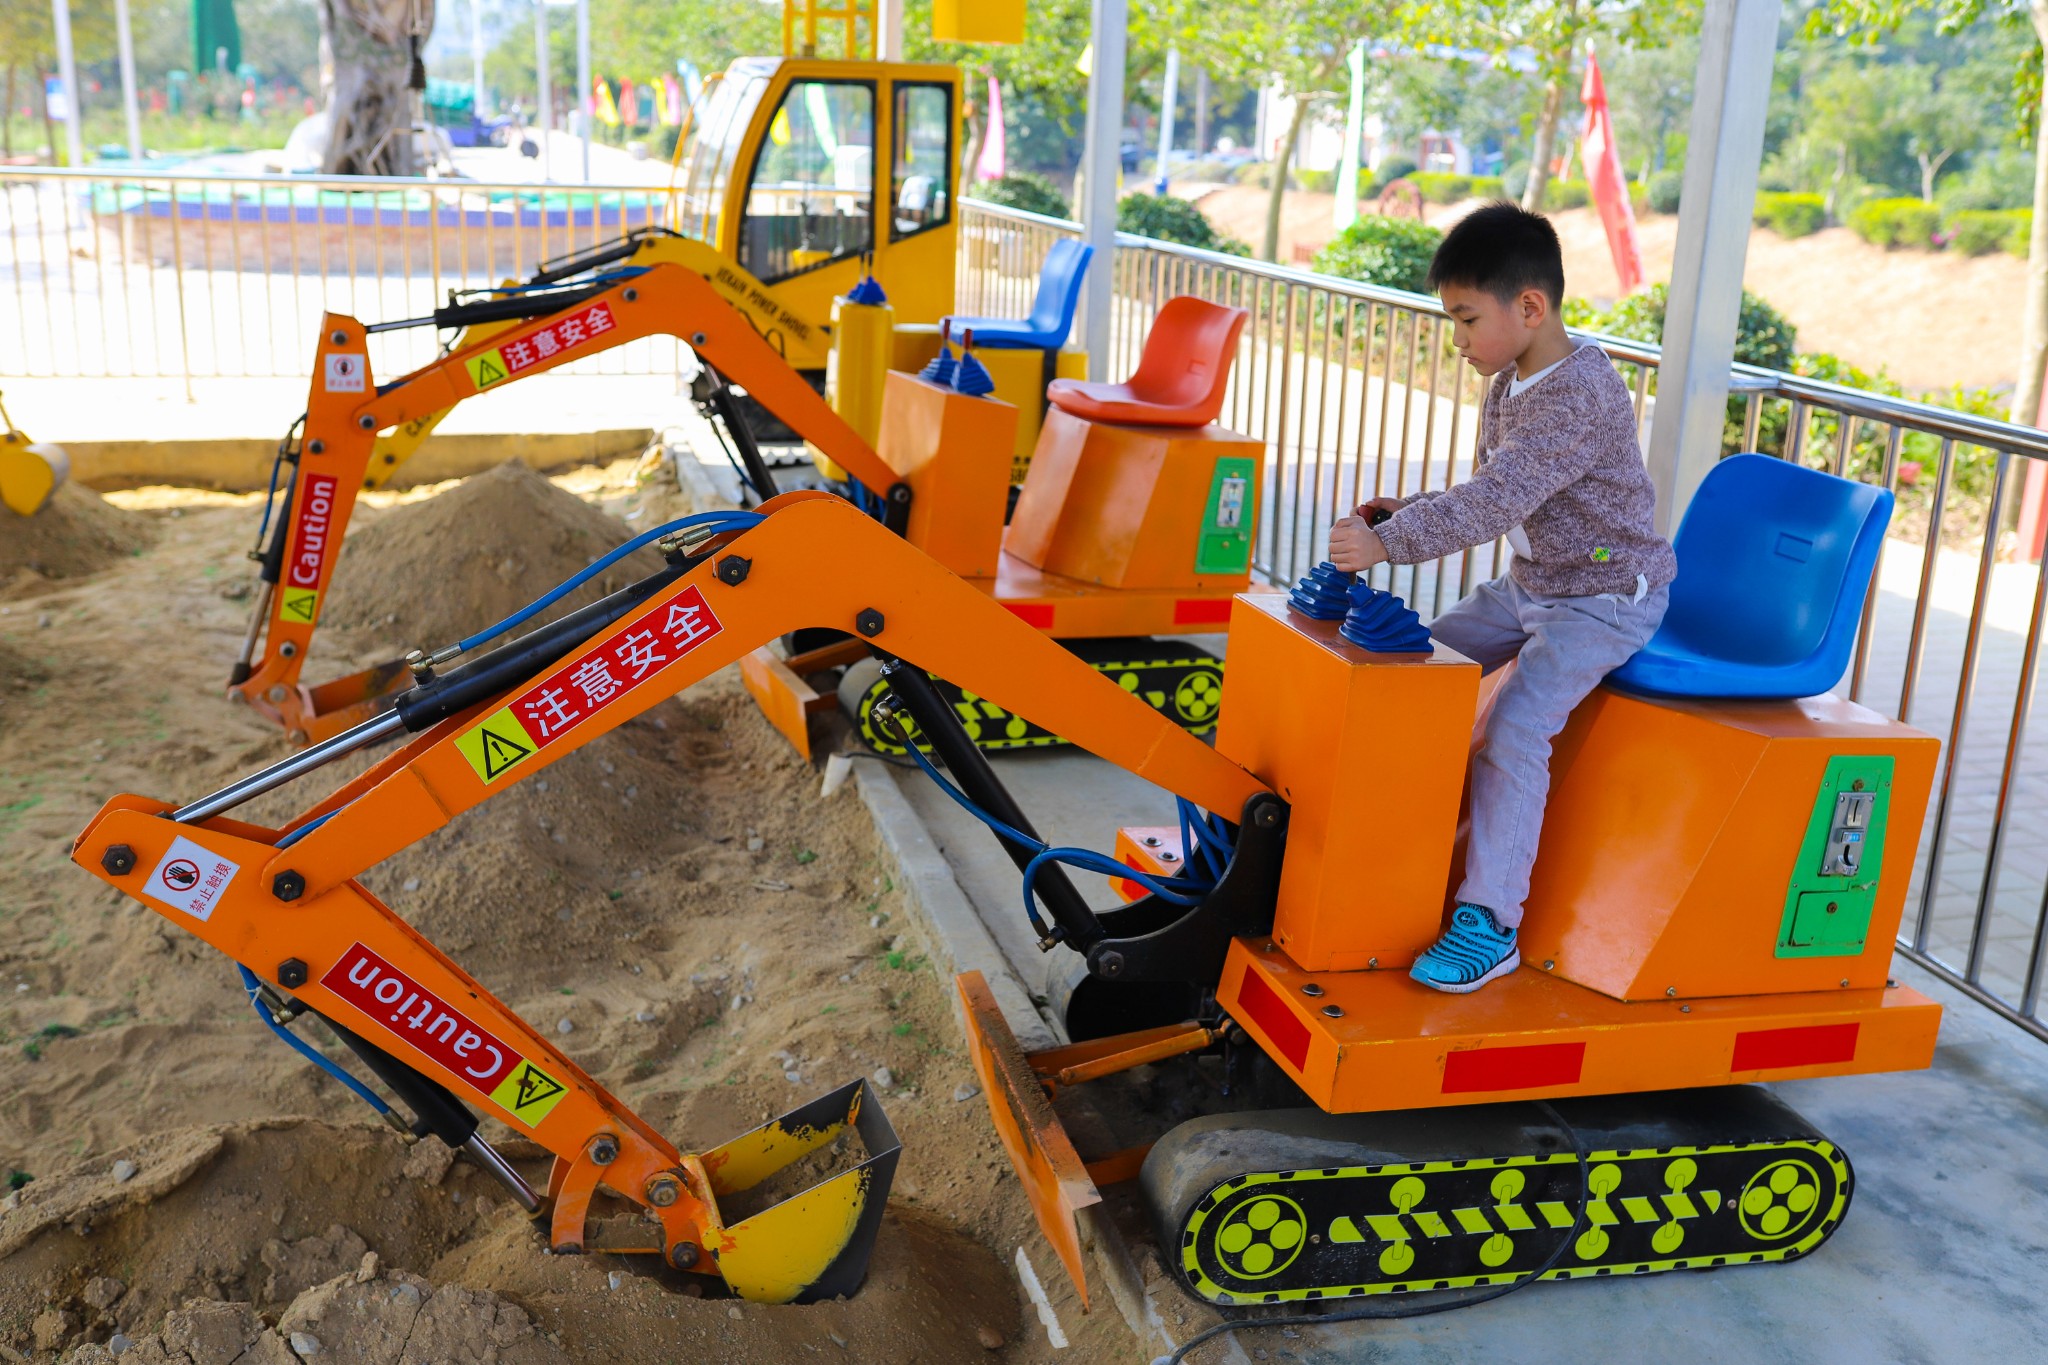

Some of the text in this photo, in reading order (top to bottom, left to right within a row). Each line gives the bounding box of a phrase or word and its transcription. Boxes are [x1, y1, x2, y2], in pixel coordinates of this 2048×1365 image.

[505, 307, 613, 370] 注意安全
[293, 481, 333, 584] Caution
[524, 603, 711, 737] 注意安全
[189, 862, 232, 913] 禁止触摸
[348, 957, 503, 1078] Caution
